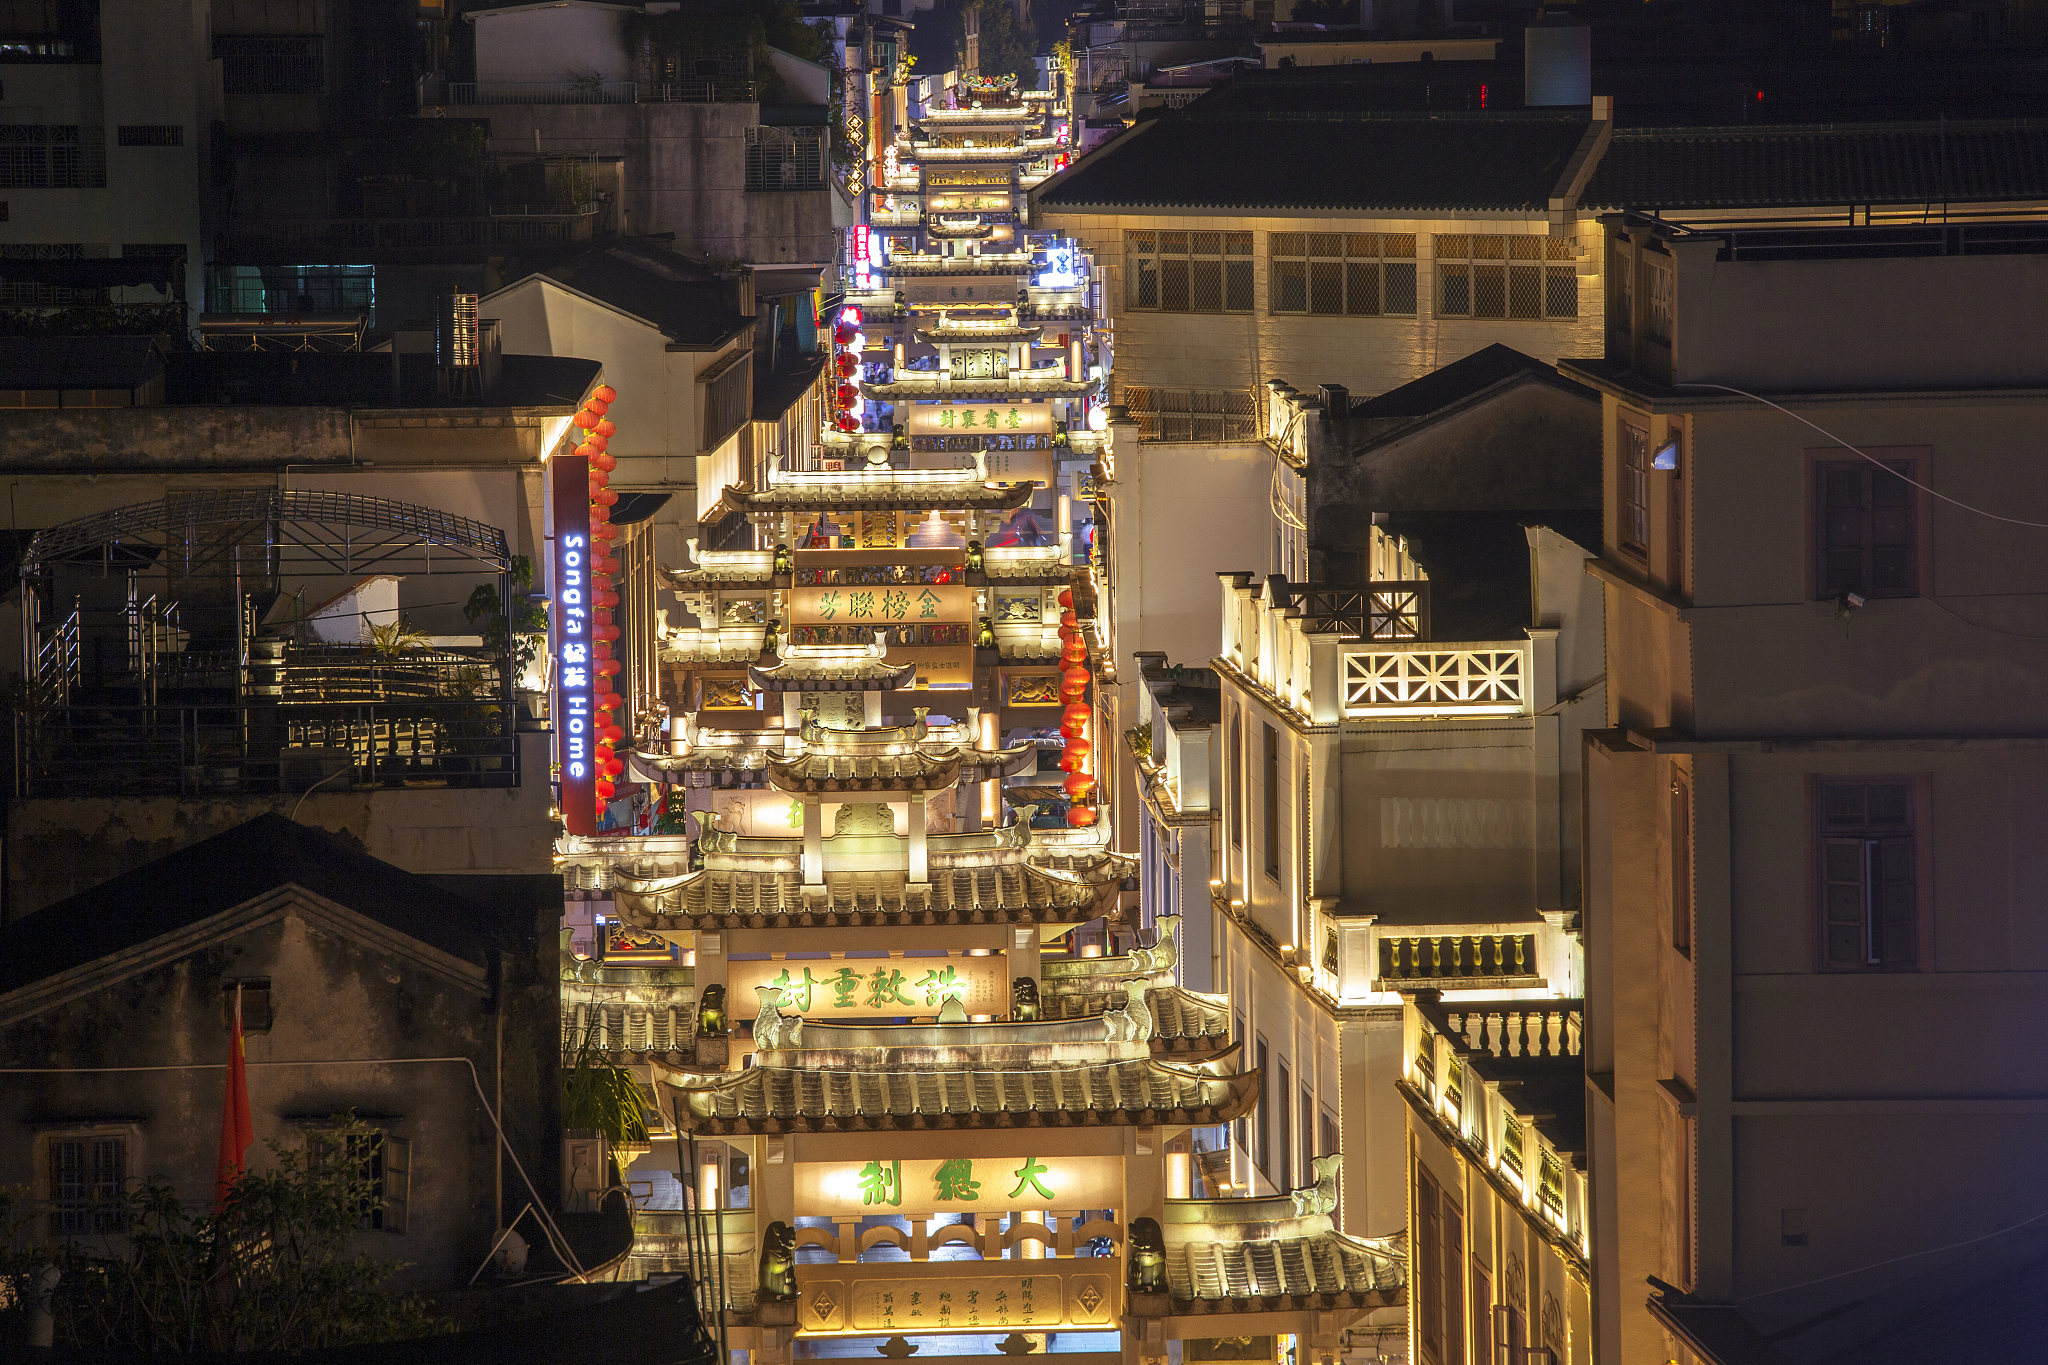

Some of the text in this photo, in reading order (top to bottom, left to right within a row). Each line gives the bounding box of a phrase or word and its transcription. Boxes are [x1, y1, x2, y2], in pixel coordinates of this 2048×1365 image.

[563, 535, 585, 634] Songfa
[819, 588, 942, 620] 金榜聯芳
[569, 697, 587, 778] Home
